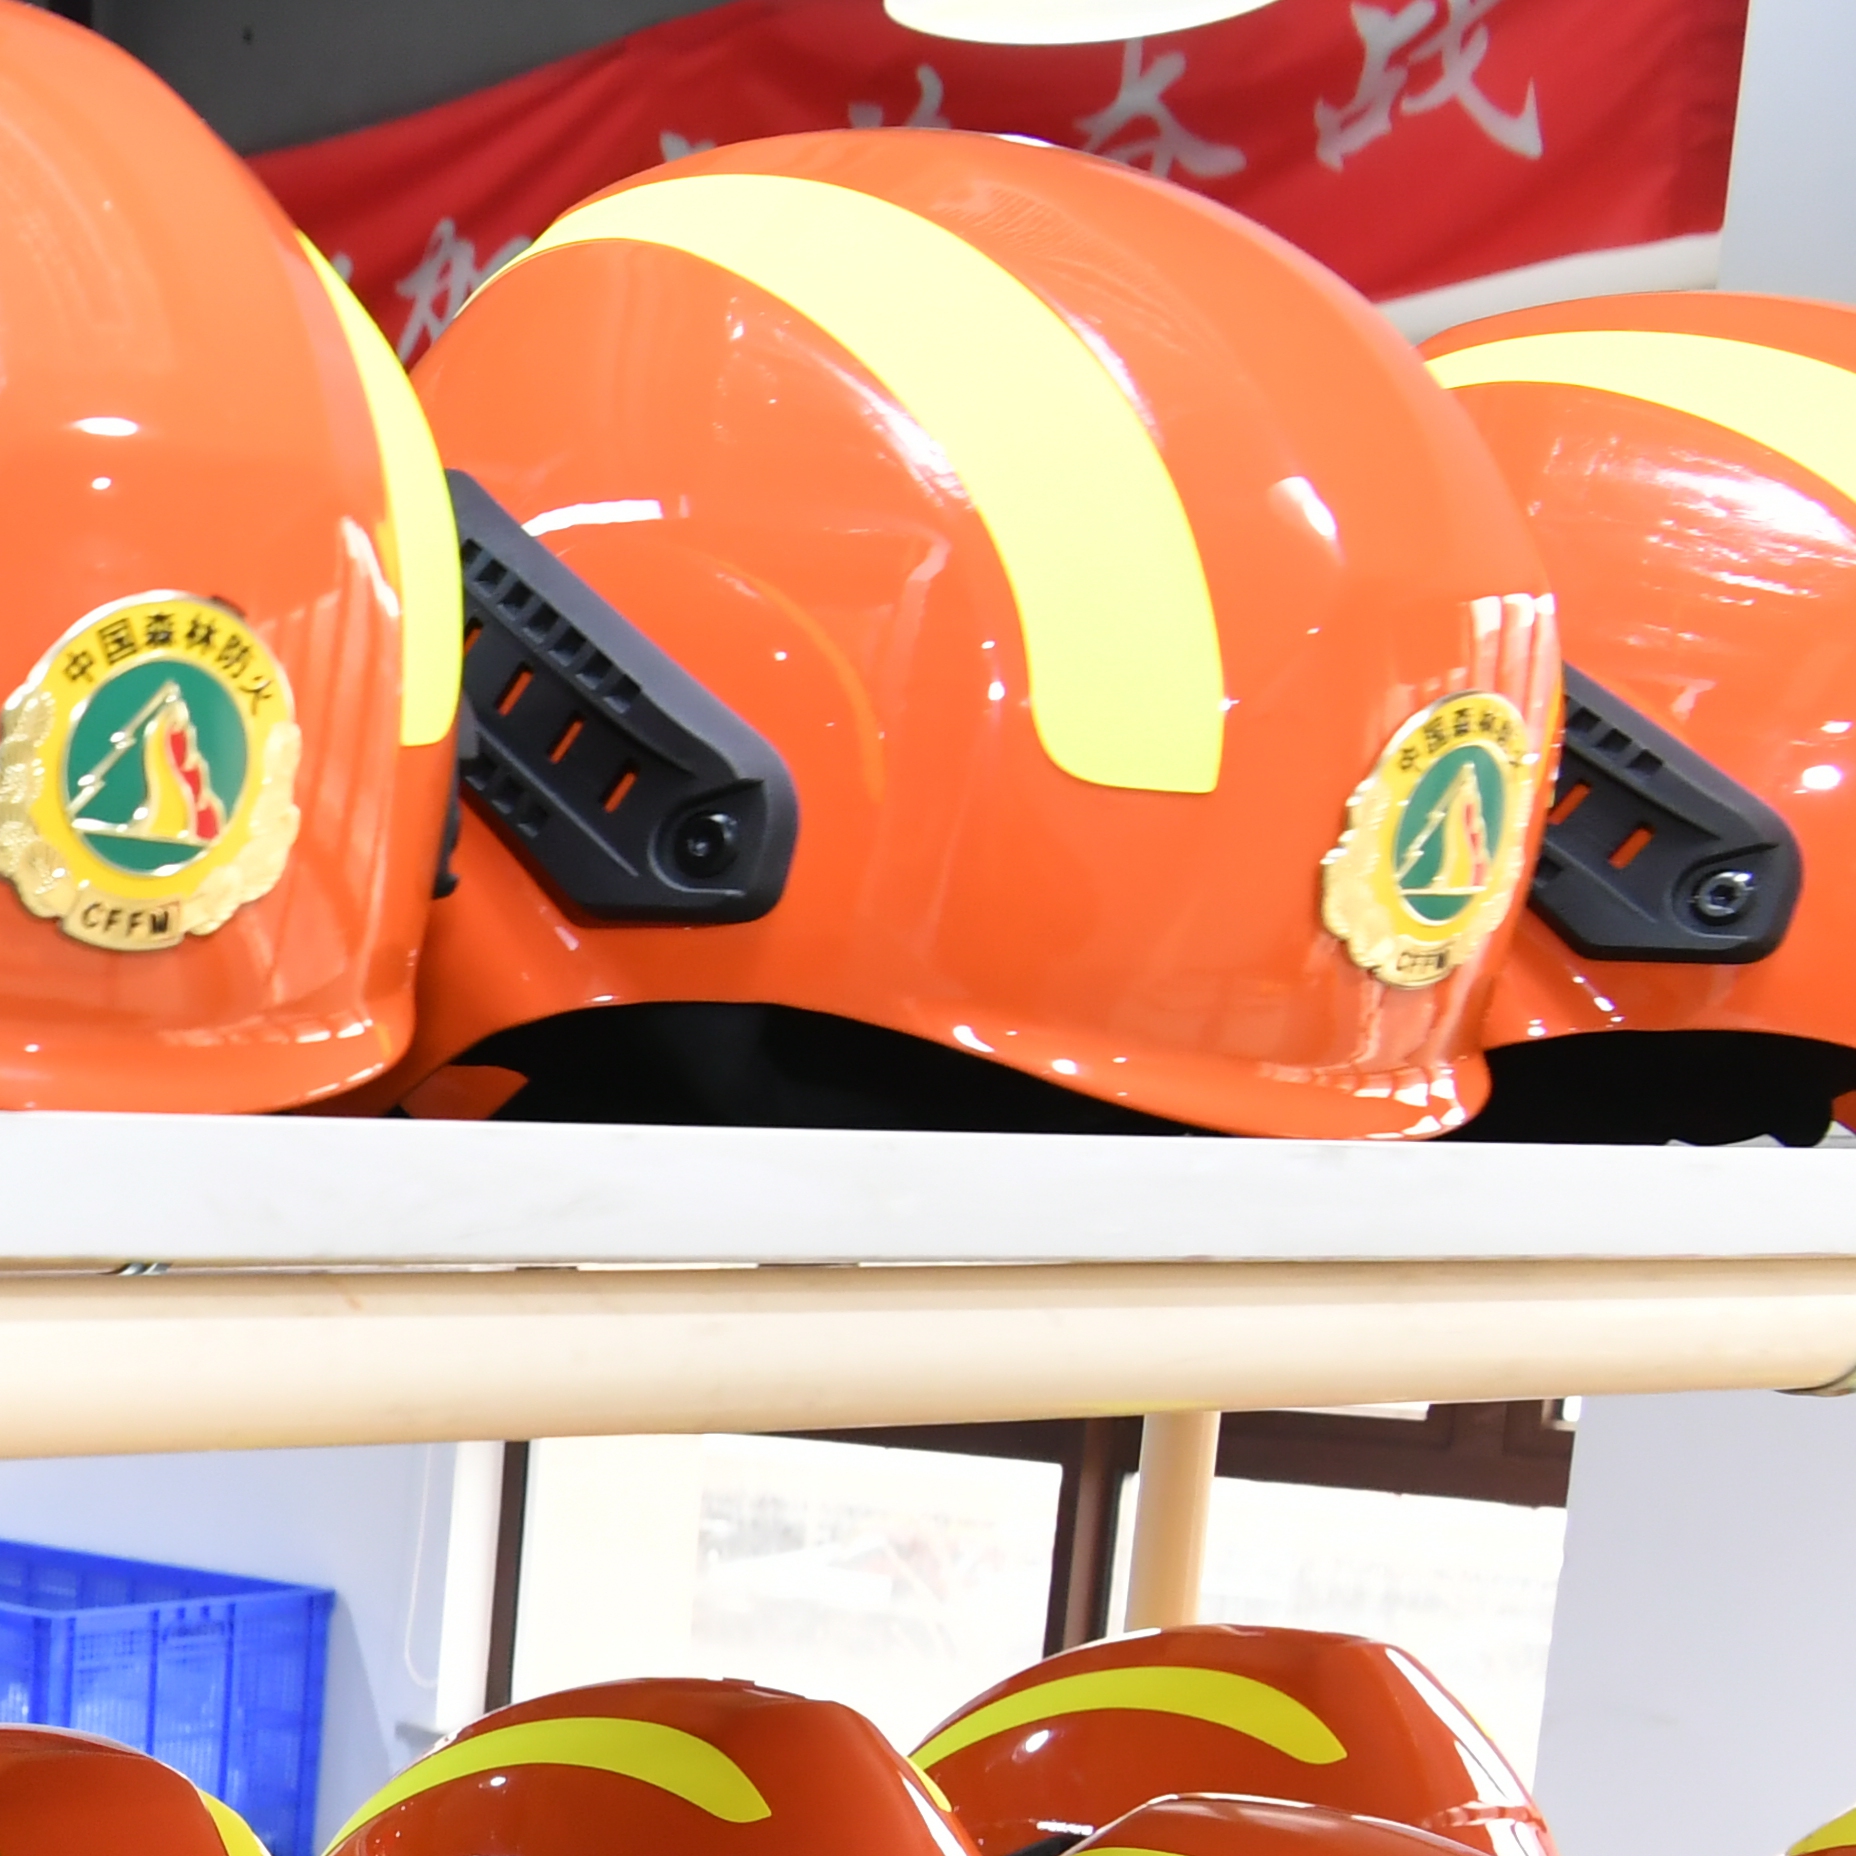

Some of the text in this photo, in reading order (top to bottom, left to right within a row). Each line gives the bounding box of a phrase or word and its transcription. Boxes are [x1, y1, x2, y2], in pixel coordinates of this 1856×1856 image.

[63, 612, 273, 716] 中国森林防火
